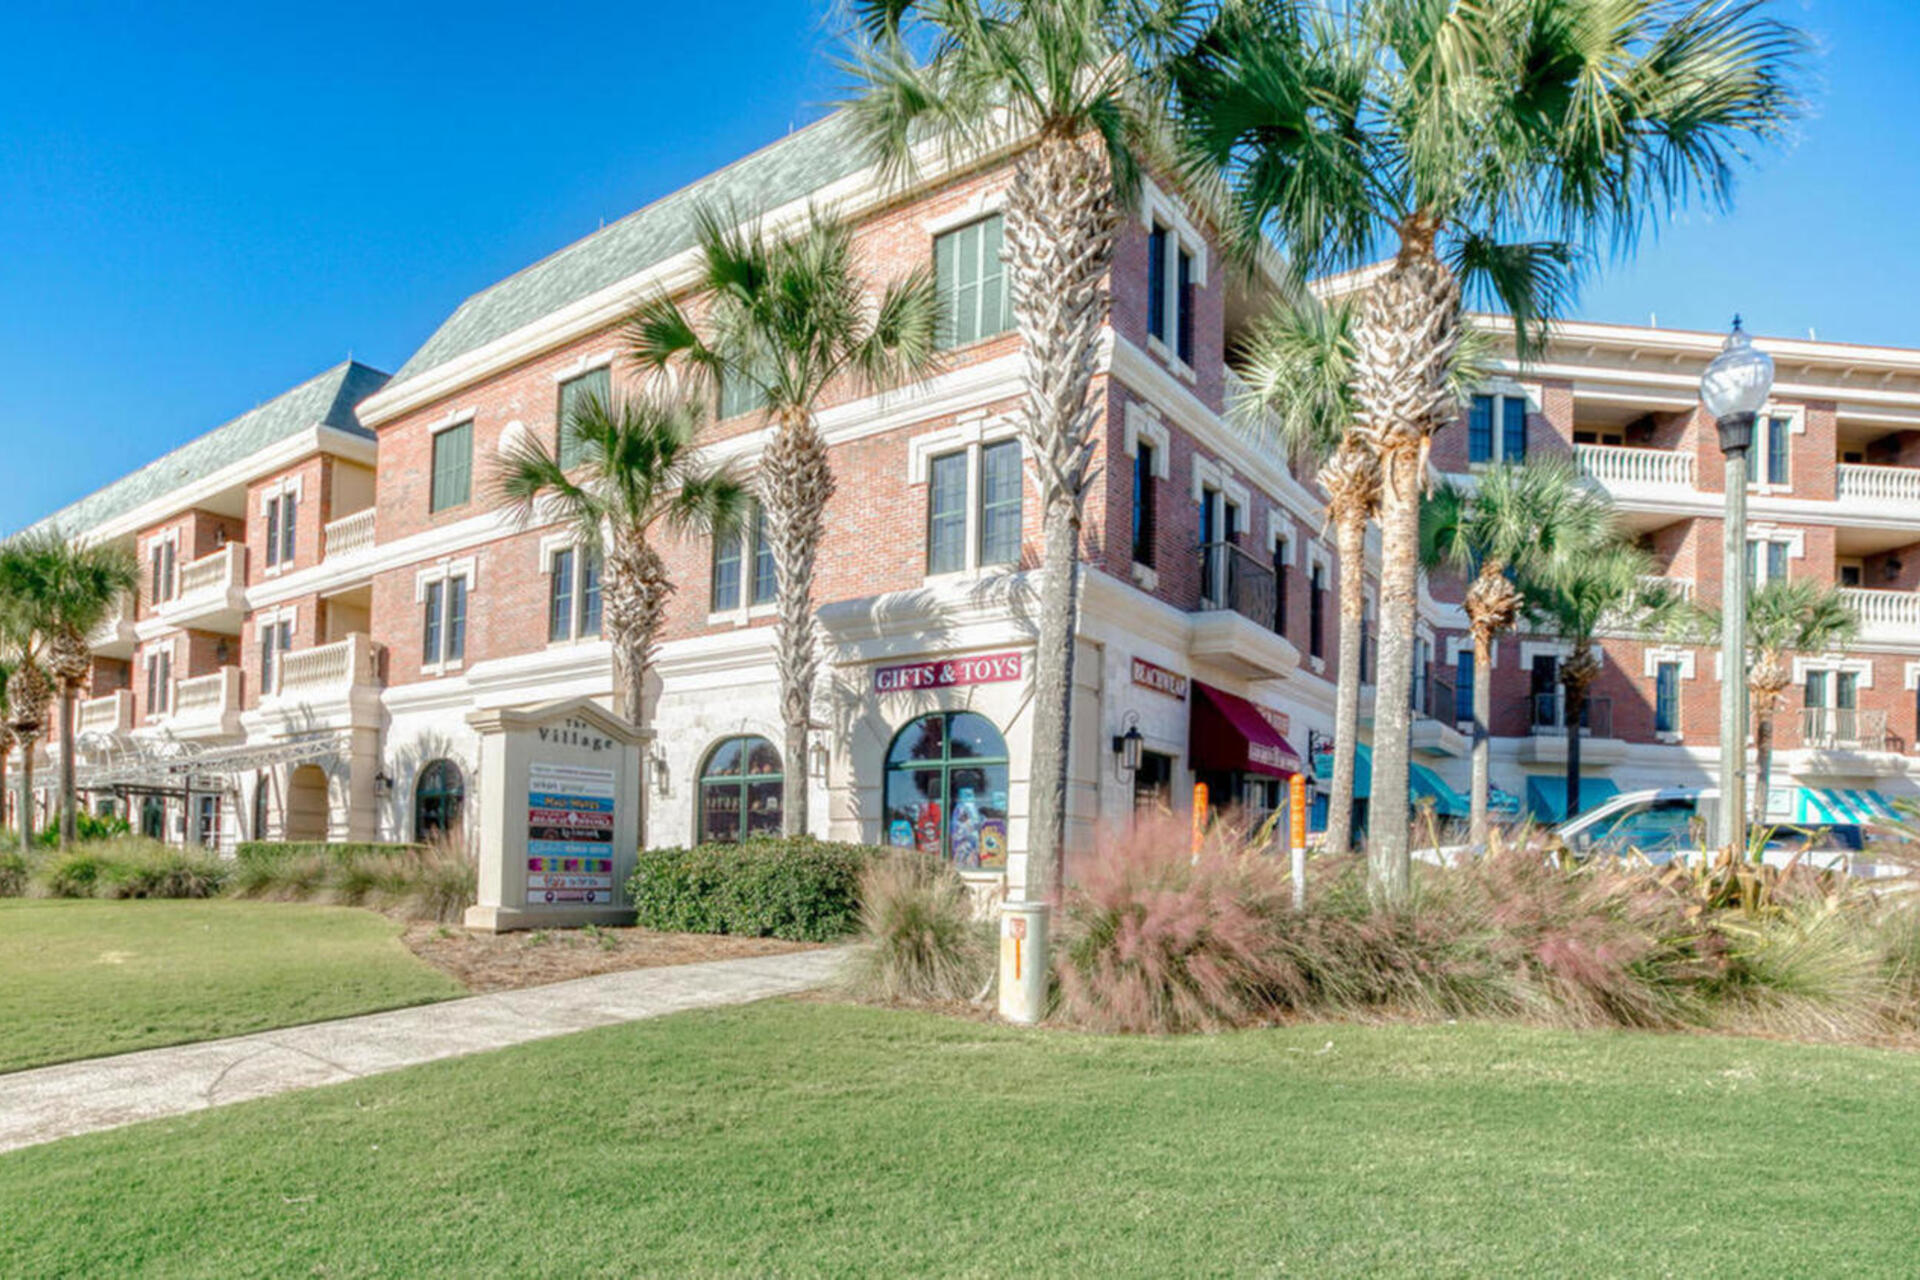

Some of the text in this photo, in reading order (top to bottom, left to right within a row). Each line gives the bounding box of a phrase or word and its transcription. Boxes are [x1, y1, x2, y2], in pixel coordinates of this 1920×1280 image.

[877, 656, 1019, 689] GIFTS & TOYS
[565, 718, 588, 729] The
[538, 727, 613, 751] Village
